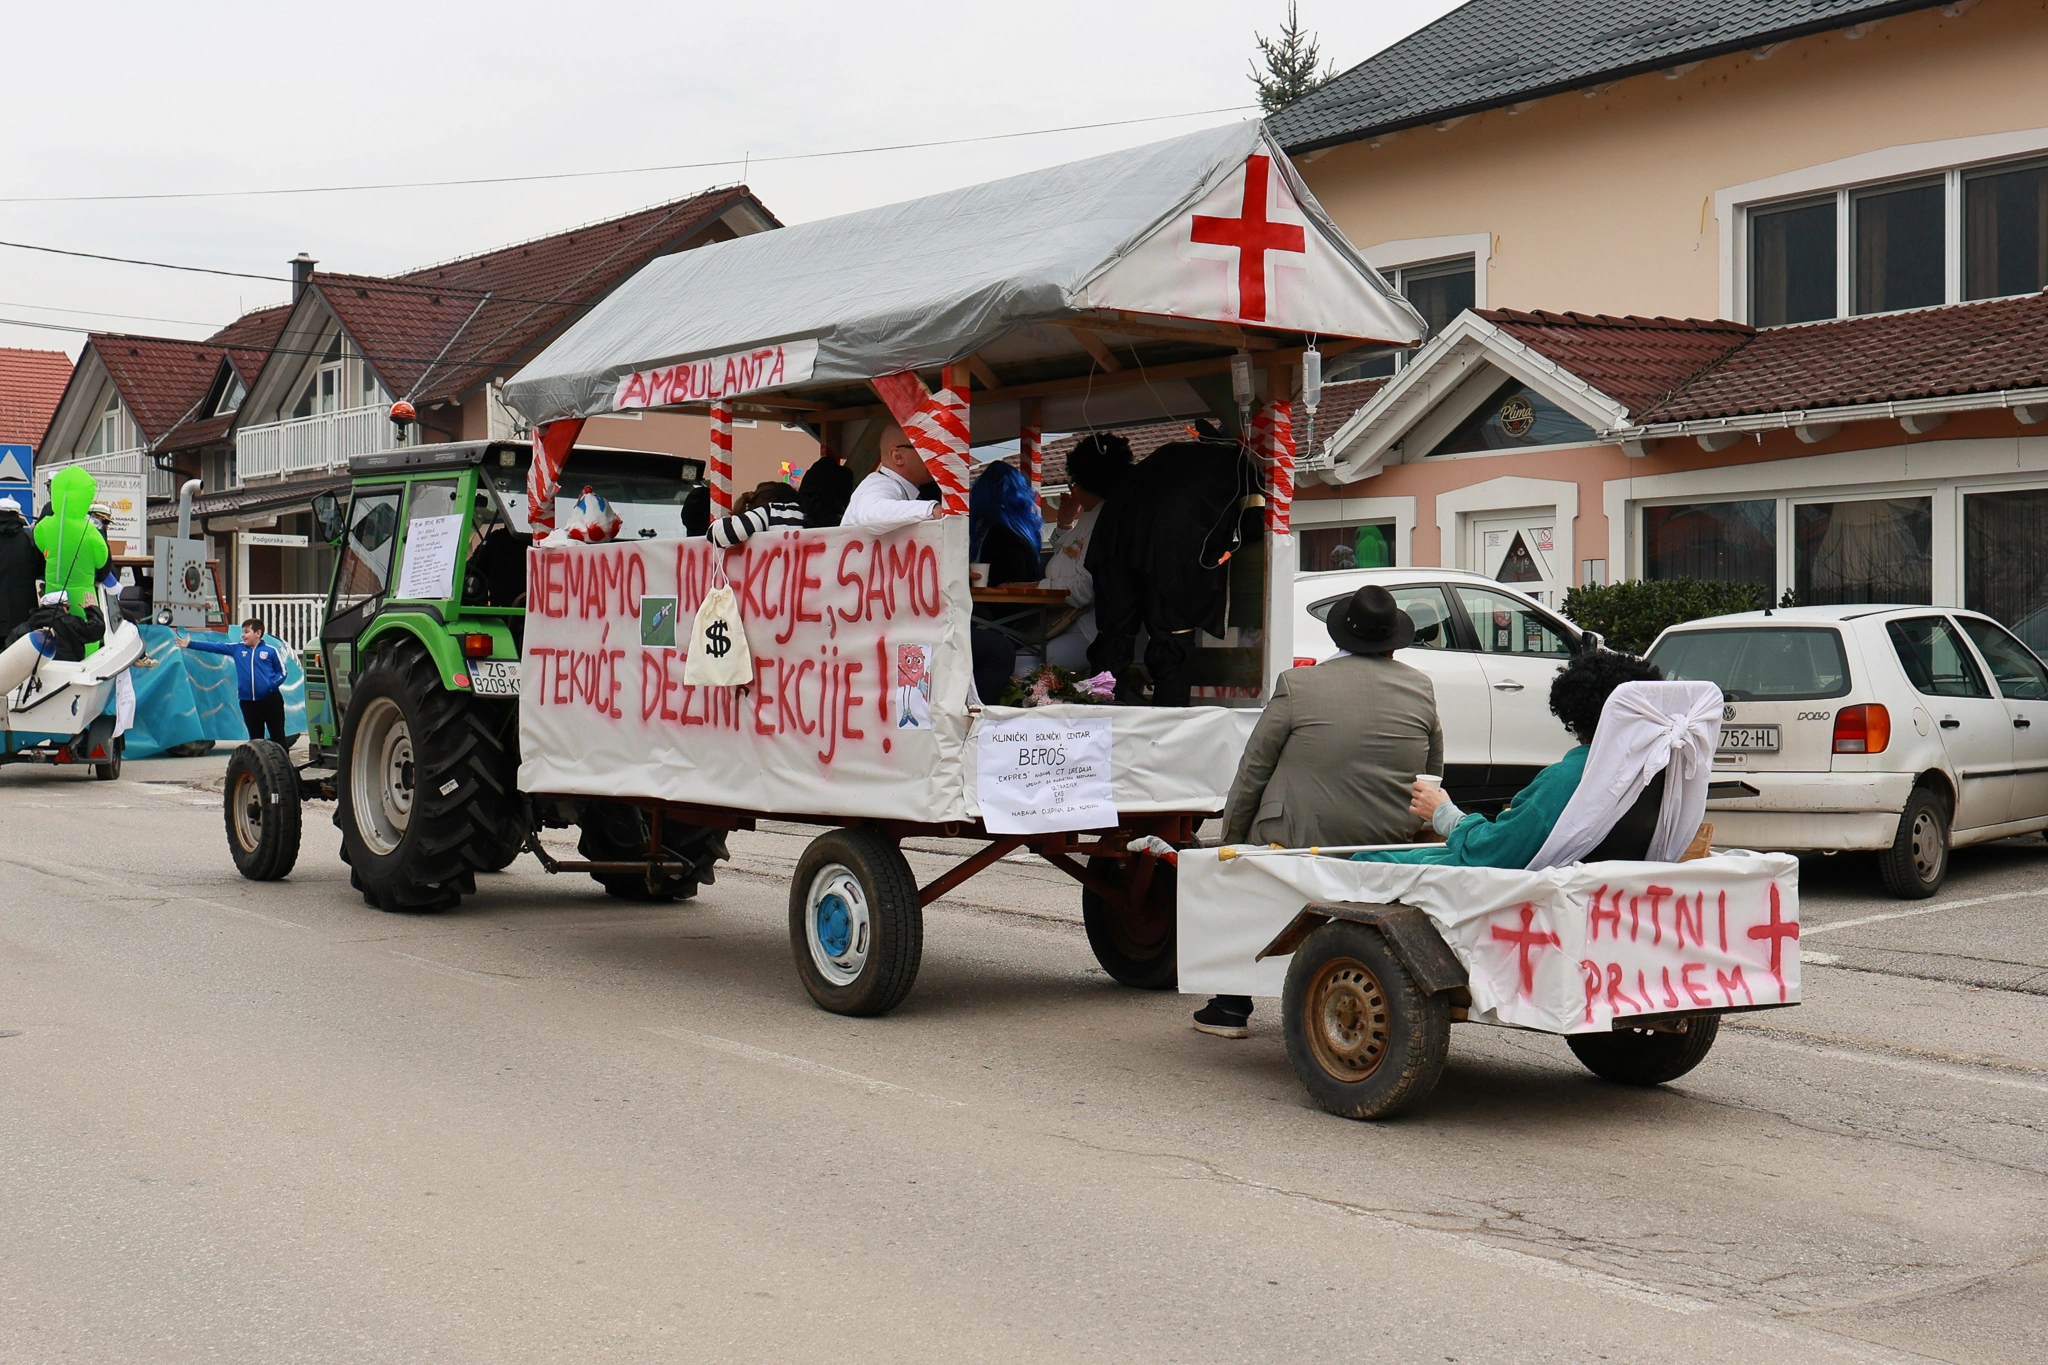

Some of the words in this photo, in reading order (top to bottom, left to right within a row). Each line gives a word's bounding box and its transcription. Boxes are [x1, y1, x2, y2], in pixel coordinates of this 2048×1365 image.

[619, 346, 785, 407] AMBULANTA
[1501, 404, 1533, 421] Plima
[253, 536, 284, 544] Podgorska
[529, 550, 646, 619] NEMAMO
[838, 539, 940, 622] SAMO
[485, 663, 506, 677] ZG
[530, 622, 626, 719] TEKUĆE
[1797, 712, 1830, 720] POLO
[992, 731, 1028, 743] KLINIČKI
[1035, 731, 1061, 741] BOLNIČKI
[1066, 731, 1091, 740] CENTAR
[1590, 884, 1727, 952] HITNI
[1580, 959, 1753, 1024] PRIJEM
